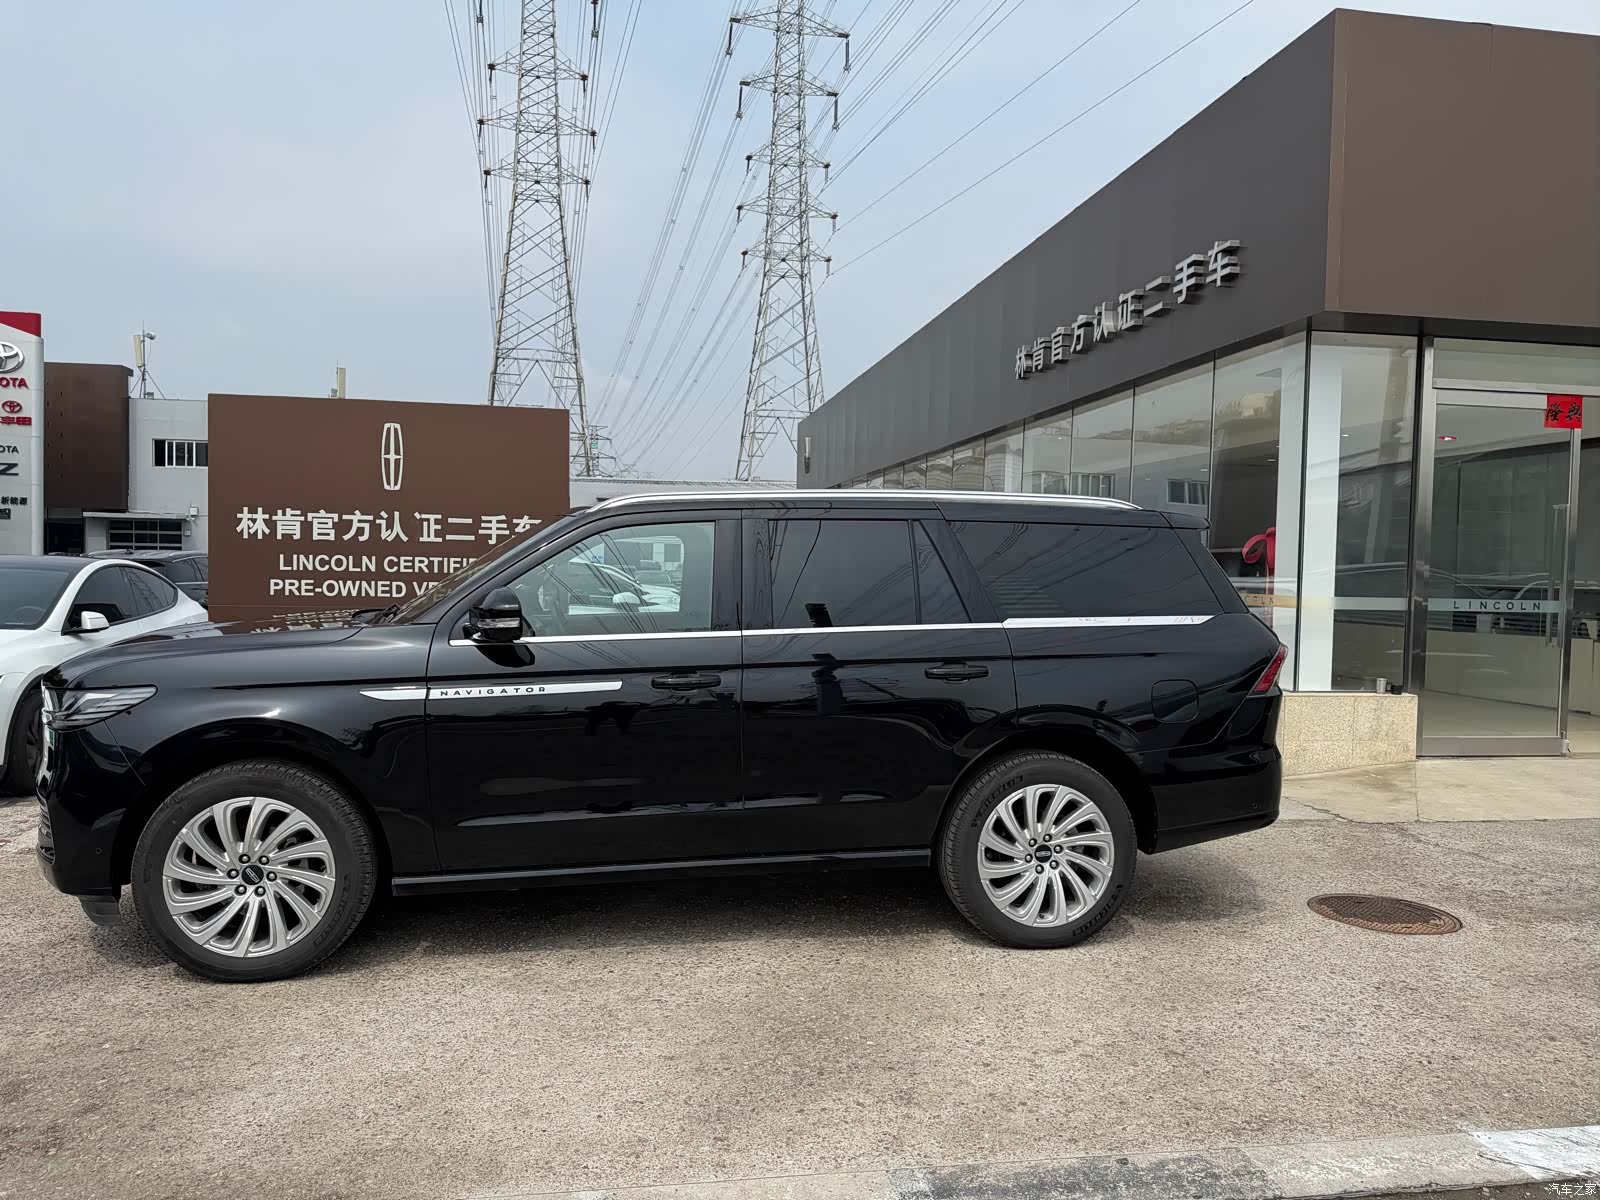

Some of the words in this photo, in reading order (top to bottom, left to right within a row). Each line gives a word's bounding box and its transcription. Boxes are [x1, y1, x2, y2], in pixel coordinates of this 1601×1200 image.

[1015, 240, 1240, 379] 林肯官方认证二手车
[279, 554, 376, 573] LINCOLN
[383, 556, 479, 574] CERTIFI
[269, 580, 407, 598] PRE-OWNED
[1453, 600, 1541, 611] LINCOLN
[440, 686, 546, 697] NAVIGATOR
